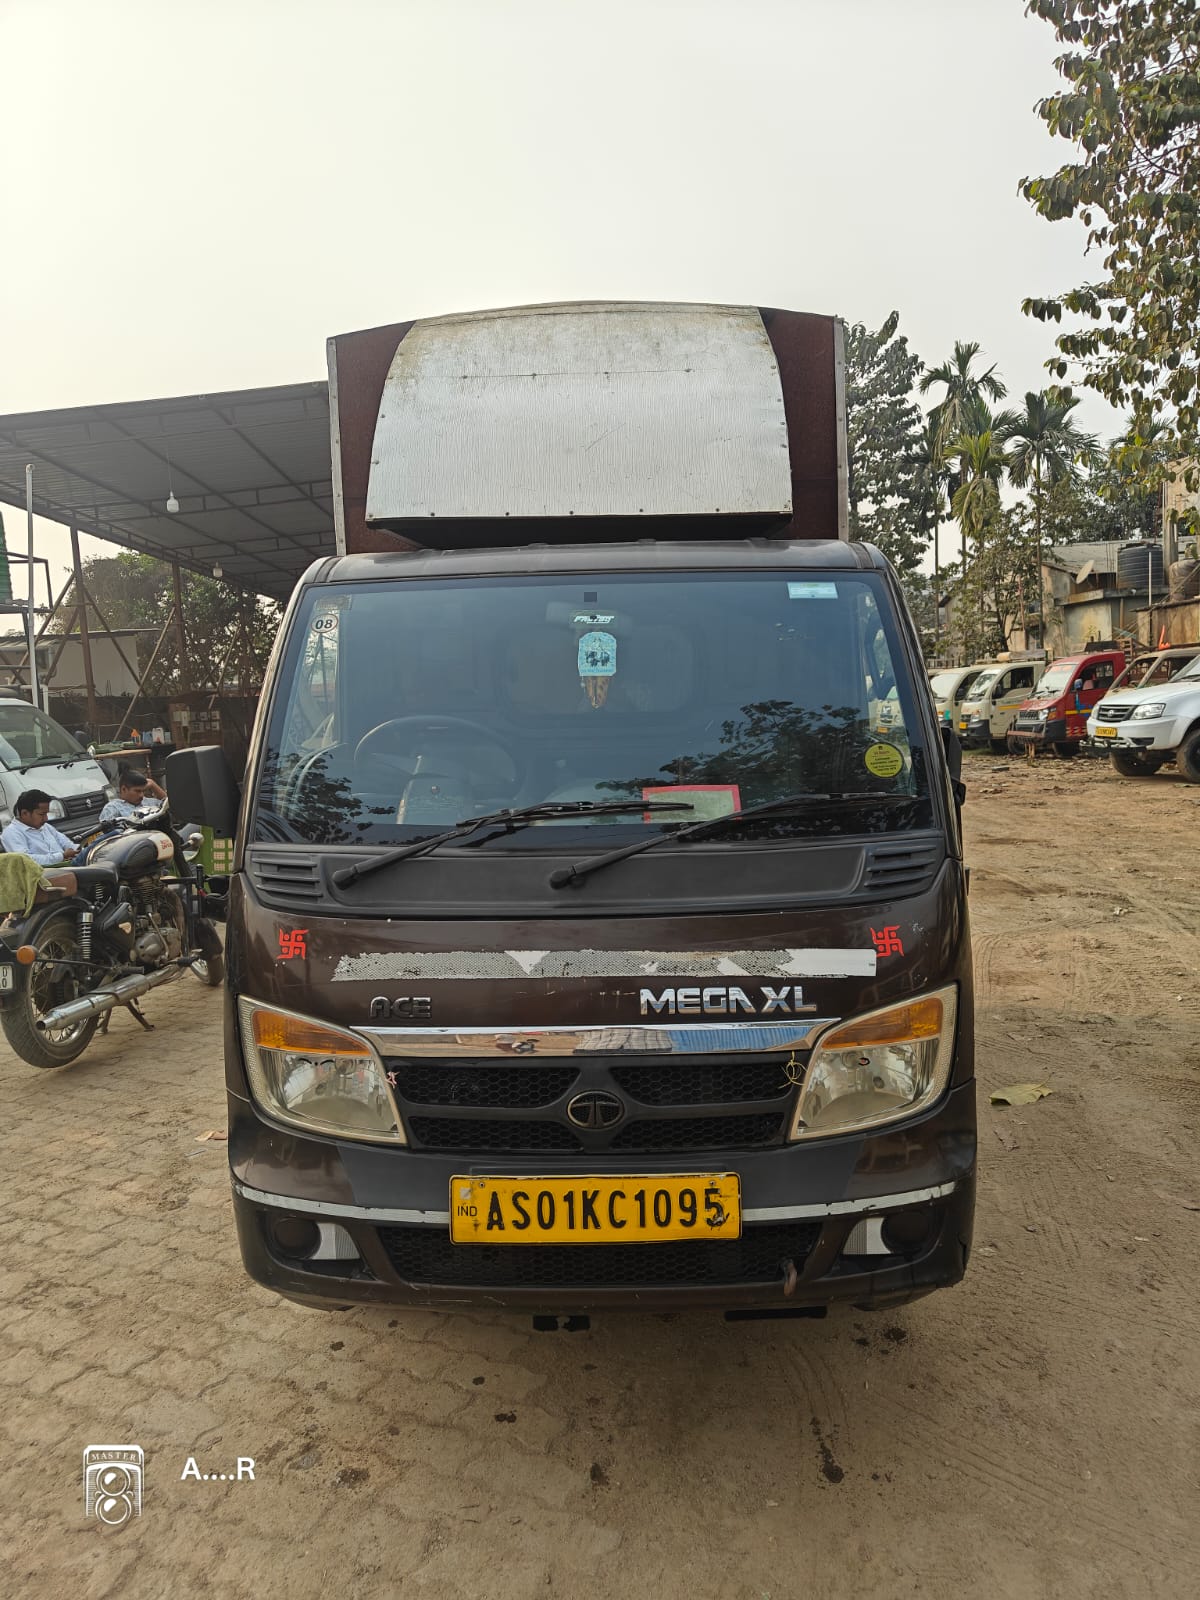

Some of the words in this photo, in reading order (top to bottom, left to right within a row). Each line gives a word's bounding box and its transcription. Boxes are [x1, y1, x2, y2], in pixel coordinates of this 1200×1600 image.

[315, 619, 333, 629] 08
[369, 996, 432, 1019] ACE
[639, 987, 756, 1015] MEGA
[759, 985, 818, 1013] XL
[457, 1205, 478, 1217] IND
[486, 1188, 727, 1231] AS01KC1095
